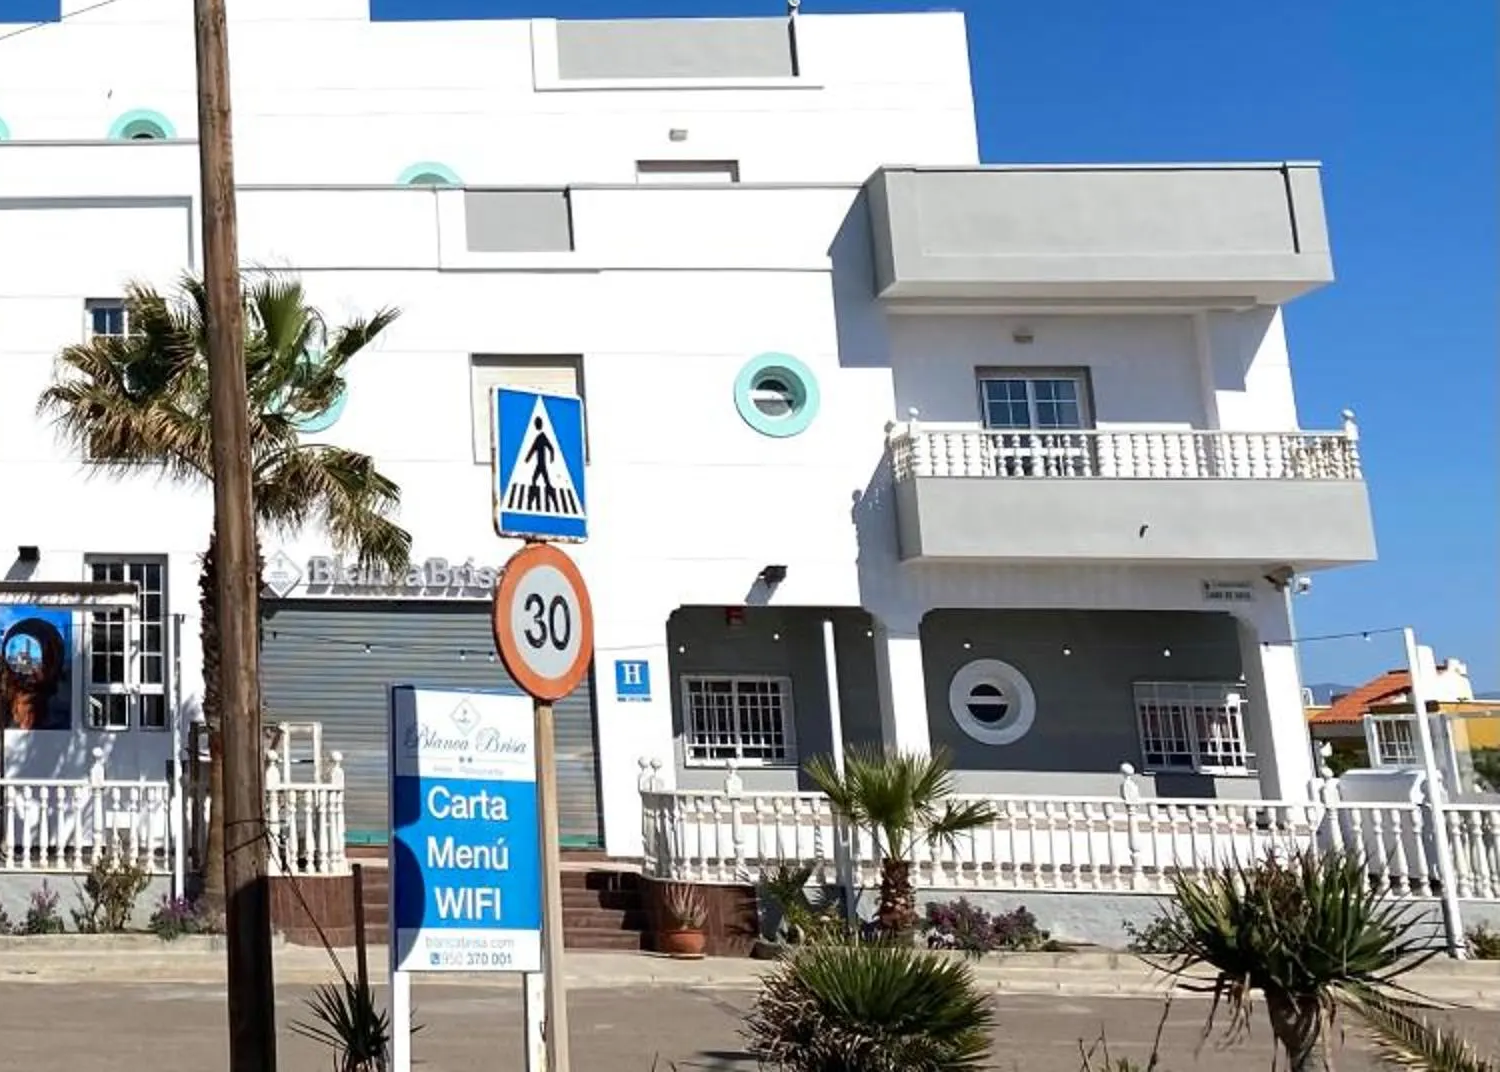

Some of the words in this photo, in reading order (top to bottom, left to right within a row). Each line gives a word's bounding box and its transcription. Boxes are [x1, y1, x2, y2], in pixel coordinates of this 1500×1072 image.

[524, 593, 572, 651] 30
[622, 663, 643, 685] H
[427, 785, 509, 822] Carta
[427, 835, 510, 871] Menú
[433, 886, 502, 922] WIFI
[466, 951, 489, 966] 370
[491, 951, 513, 966] 001
